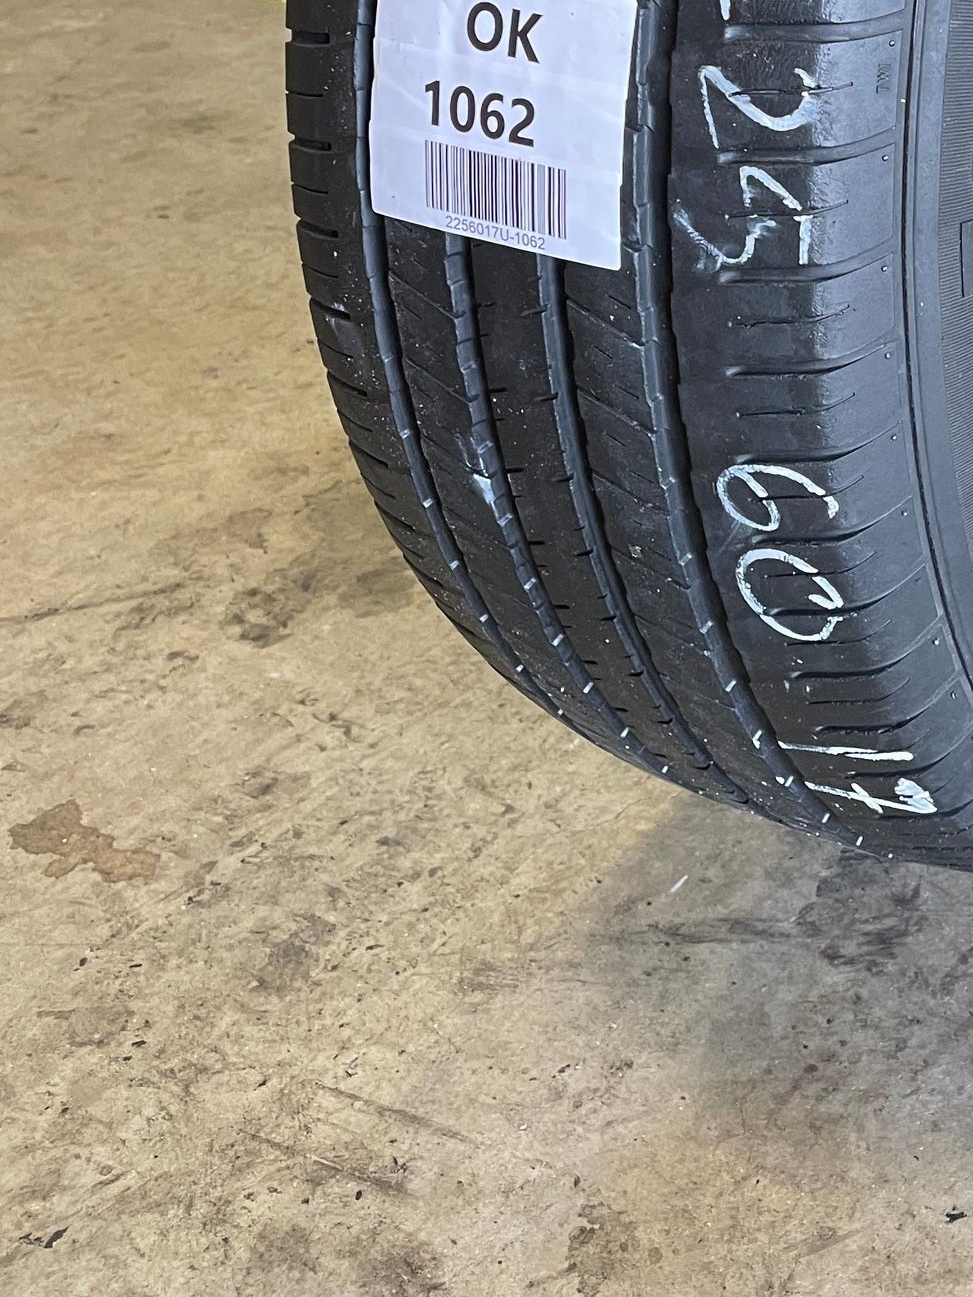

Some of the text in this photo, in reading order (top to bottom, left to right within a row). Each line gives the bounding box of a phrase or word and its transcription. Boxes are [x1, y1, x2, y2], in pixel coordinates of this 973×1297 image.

[466, 0, 545, 65] OK
[424, 79, 536, 148] 1062
[444, 214, 547, 251] 2256017U-1062
[714, 462, 846, 643] 60
